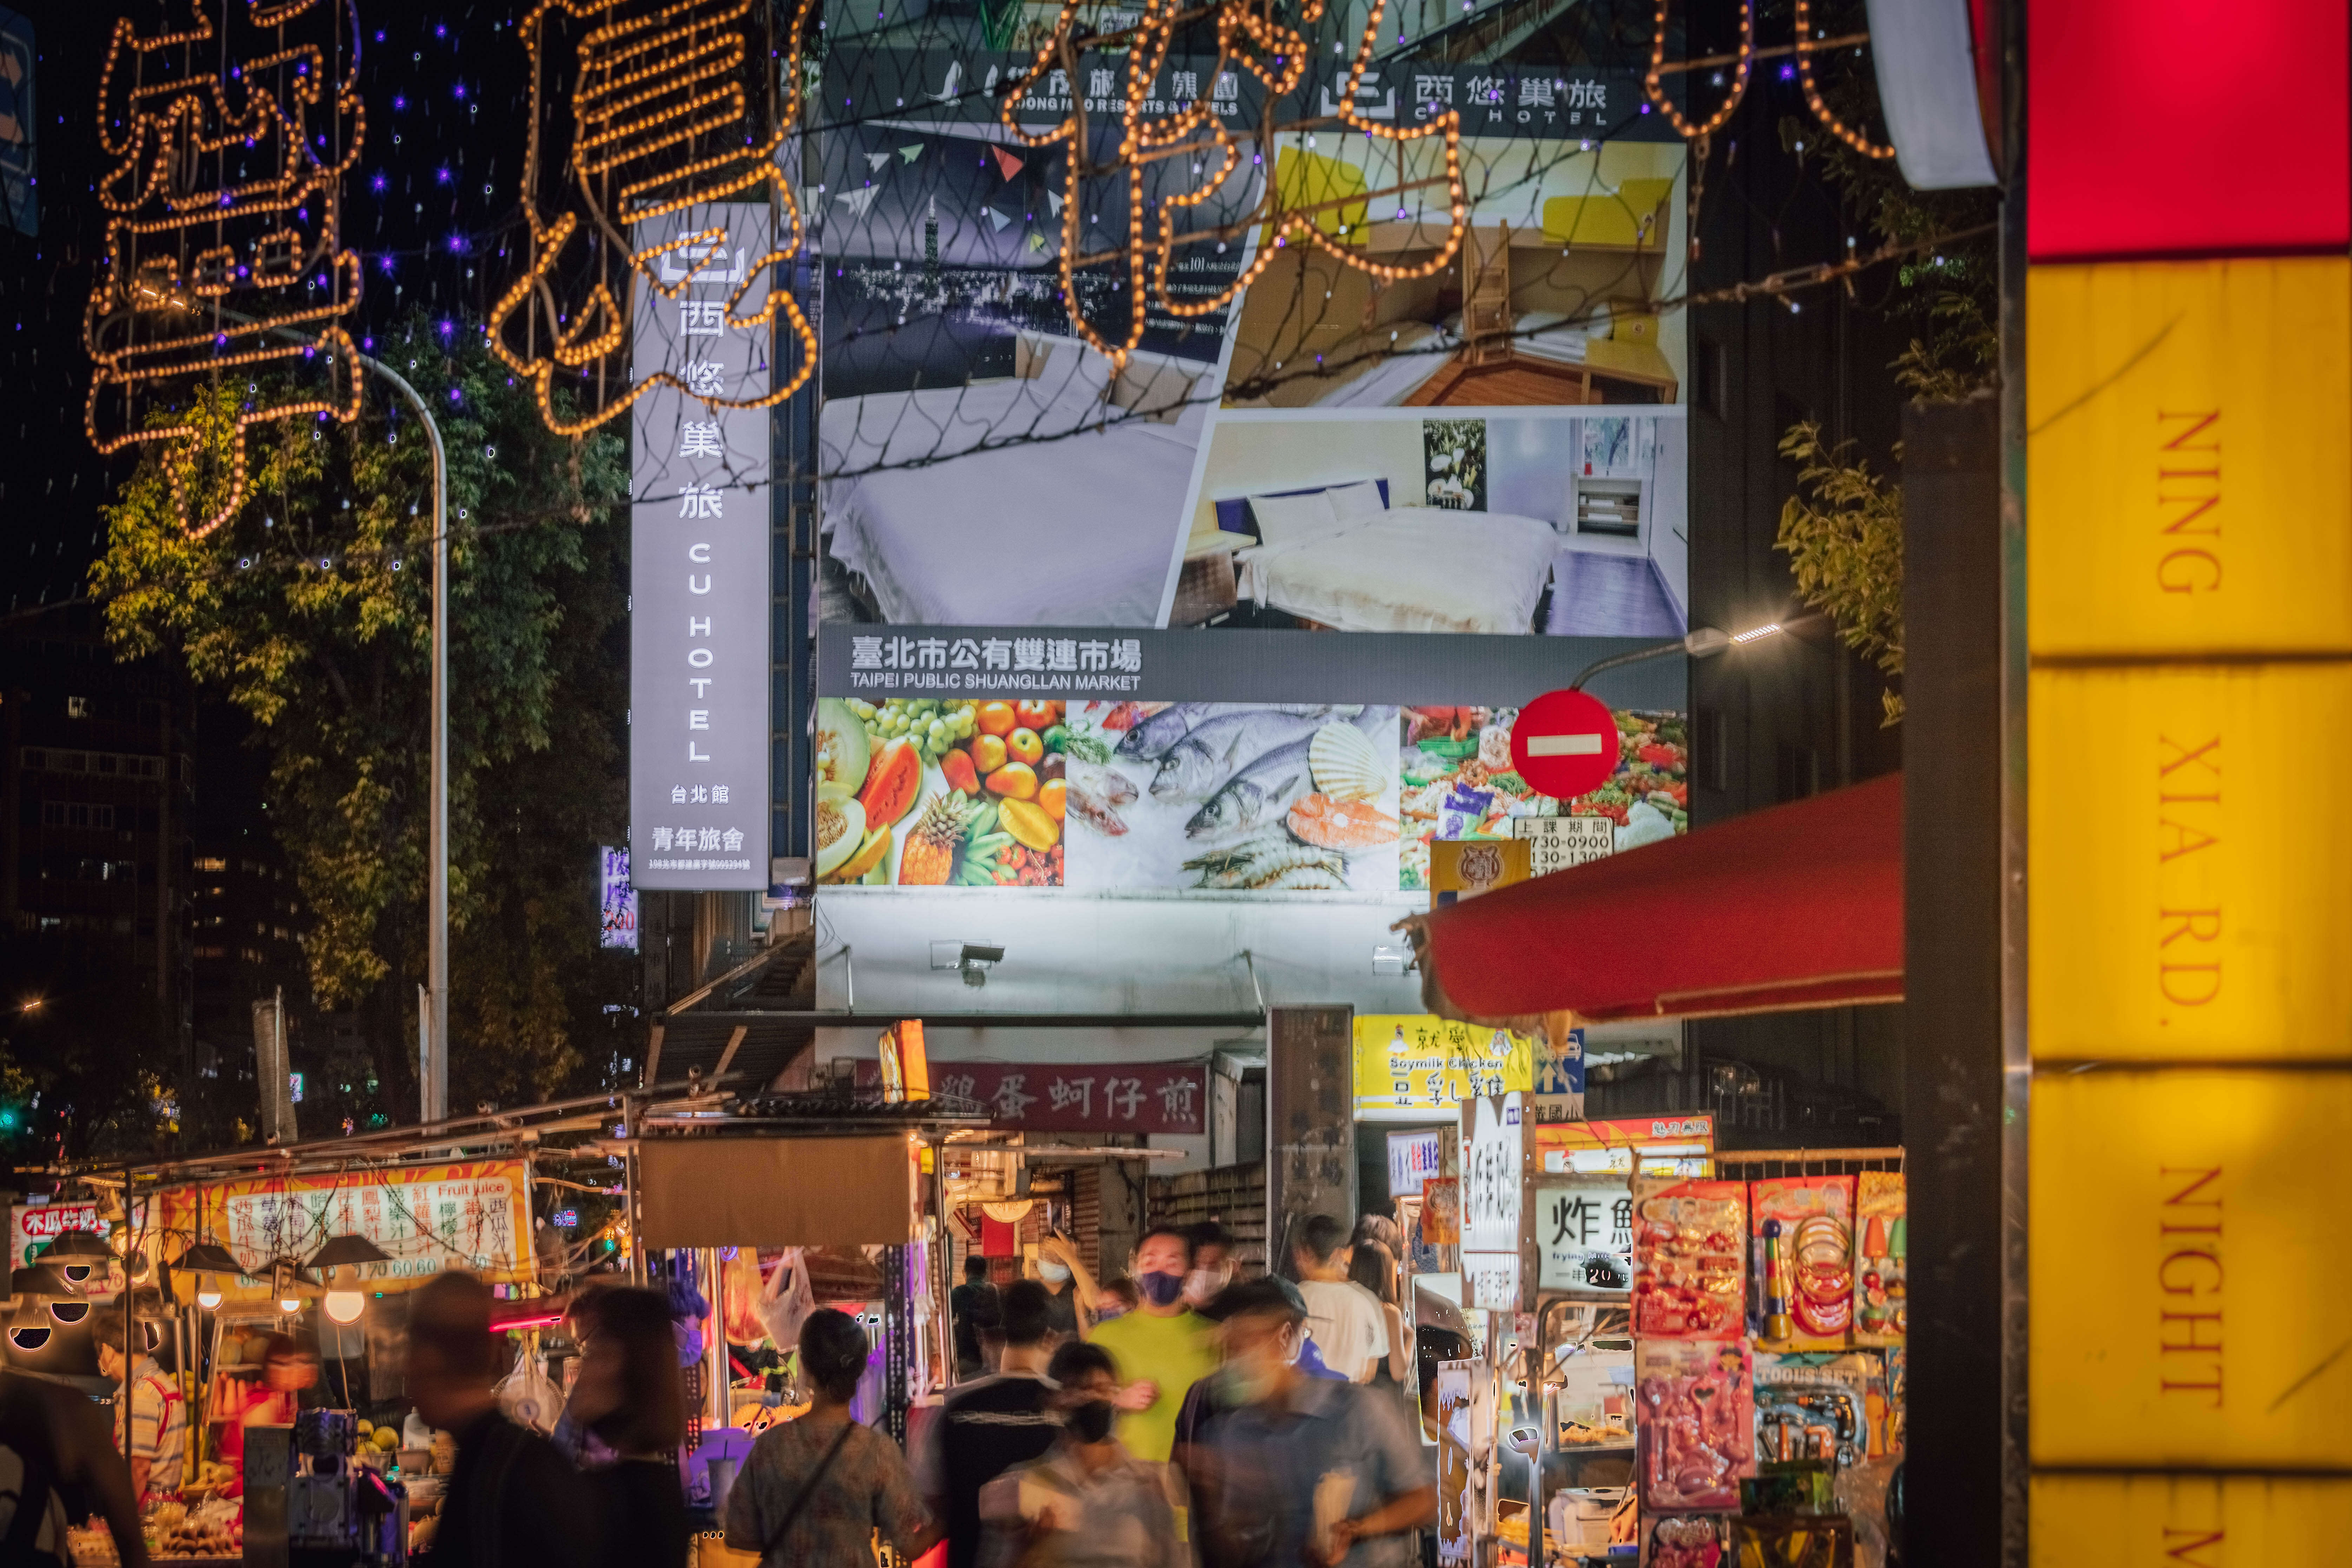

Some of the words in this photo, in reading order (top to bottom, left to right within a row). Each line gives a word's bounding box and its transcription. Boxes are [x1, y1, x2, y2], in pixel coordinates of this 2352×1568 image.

[1415, 74, 1606, 110] 西悠巢旅
[1061, 98, 1094, 112] MO
[1097, 99, 1165, 114] RESRTS
[1489, 109, 1607, 126] HOTEL
[678, 300, 725, 520] 西悠巢旅
[2158, 408, 2222, 595] NING
[688, 543, 712, 596] CU
[851, 635, 1143, 673] 臺北市公有雙連市場
[688, 615, 714, 762] HOTEL
[850, 672, 899, 688] TAIPEI
[903, 673, 961, 689] PUBLIC
[1075, 675, 1141, 691] MARKET
[671, 784, 730, 805] 台北館
[2159, 735, 2221, 865] XIA
[1519, 820, 1608, 834] 上課期間
[652, 826, 745, 852] 青年旅舍
[1520, 835, 1609, 850] 730-0900
[2159, 907, 2222, 1028] RD.
[1390, 1057, 1443, 1070] Soymilk
[438, 1184, 469, 1197] Fruit
[473, 1182, 505, 1195] juice
[392, 1260, 412, 1277] 60
[417, 1258, 436, 1276] 60
[2159, 1164, 2224, 1408] NIGHT
